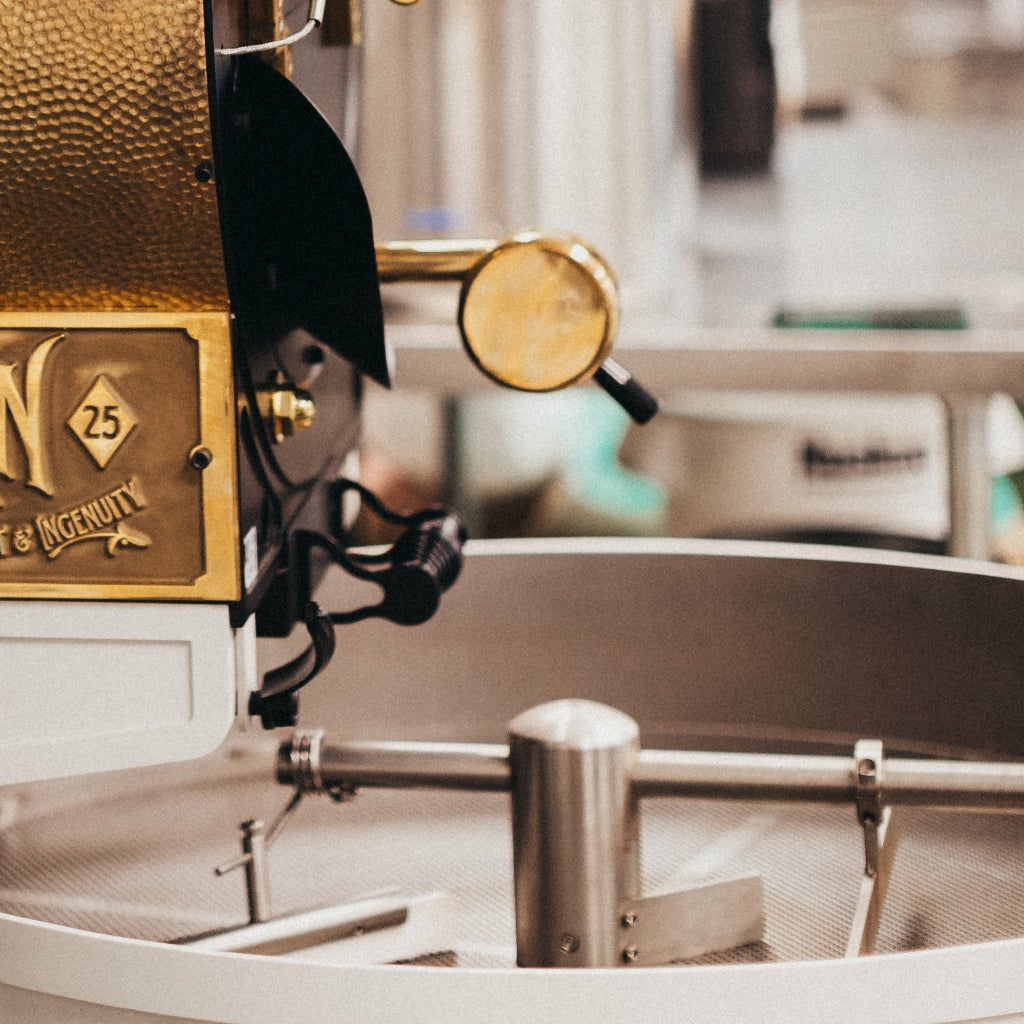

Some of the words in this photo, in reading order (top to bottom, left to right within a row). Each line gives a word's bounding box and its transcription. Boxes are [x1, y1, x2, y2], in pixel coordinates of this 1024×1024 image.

[82, 405, 121, 439] 25
[14, 526, 34, 553] &
[35, 476, 147, 552] INGENUITY
